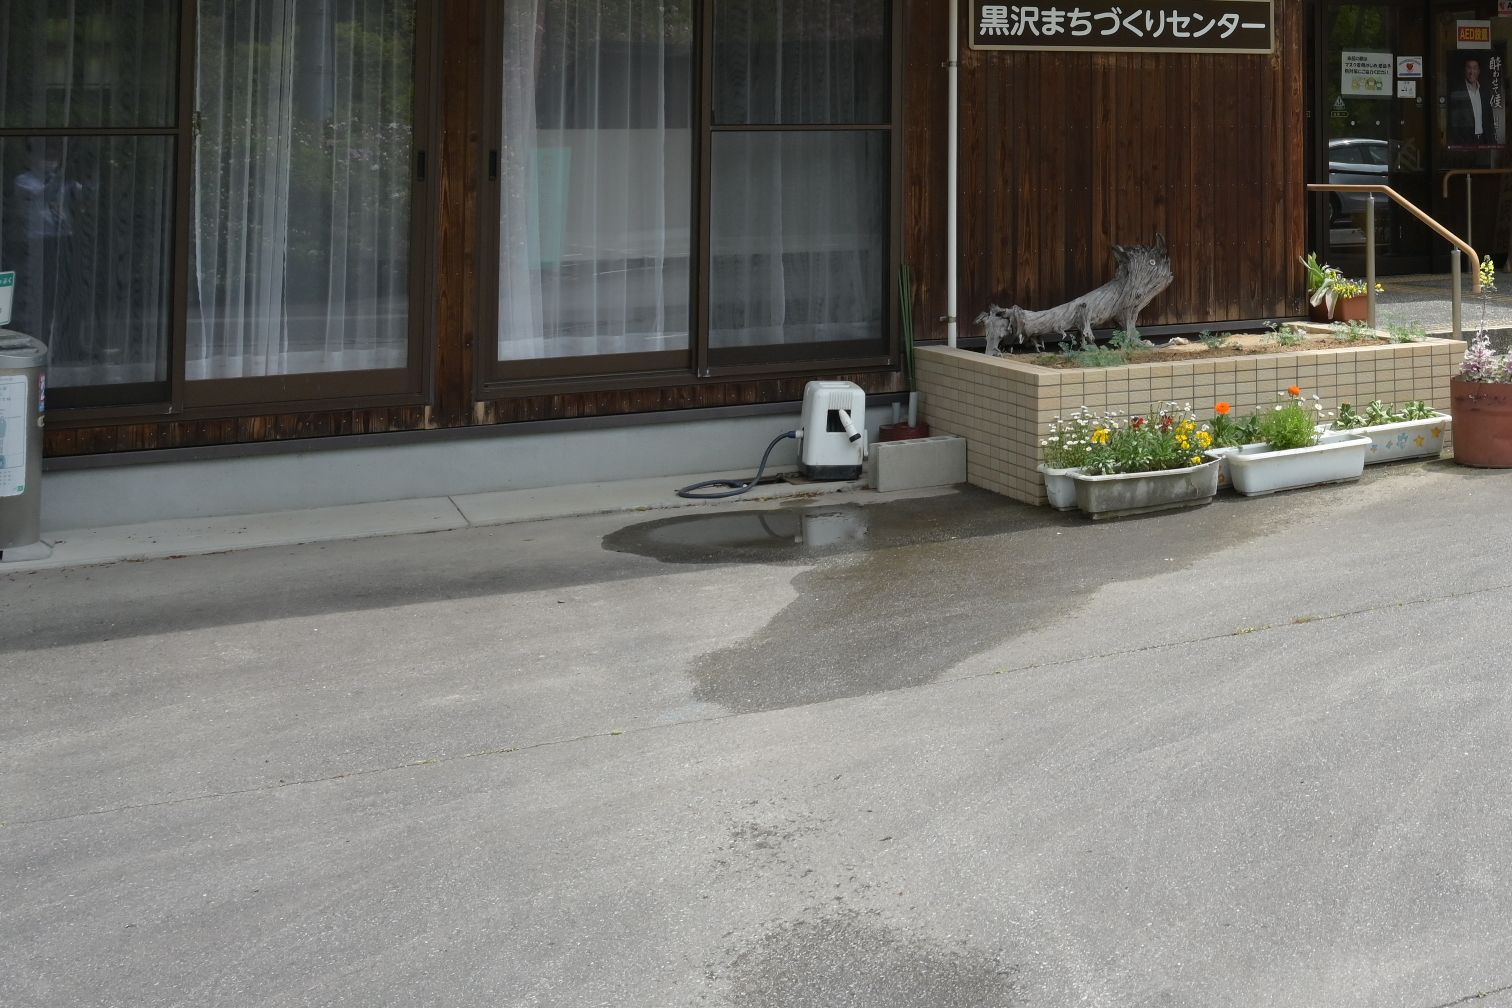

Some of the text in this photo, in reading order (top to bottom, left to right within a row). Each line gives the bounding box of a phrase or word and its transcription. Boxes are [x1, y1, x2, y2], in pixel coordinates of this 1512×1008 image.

[979, 5, 1266, 39] 黒沢まちづくりセンター
